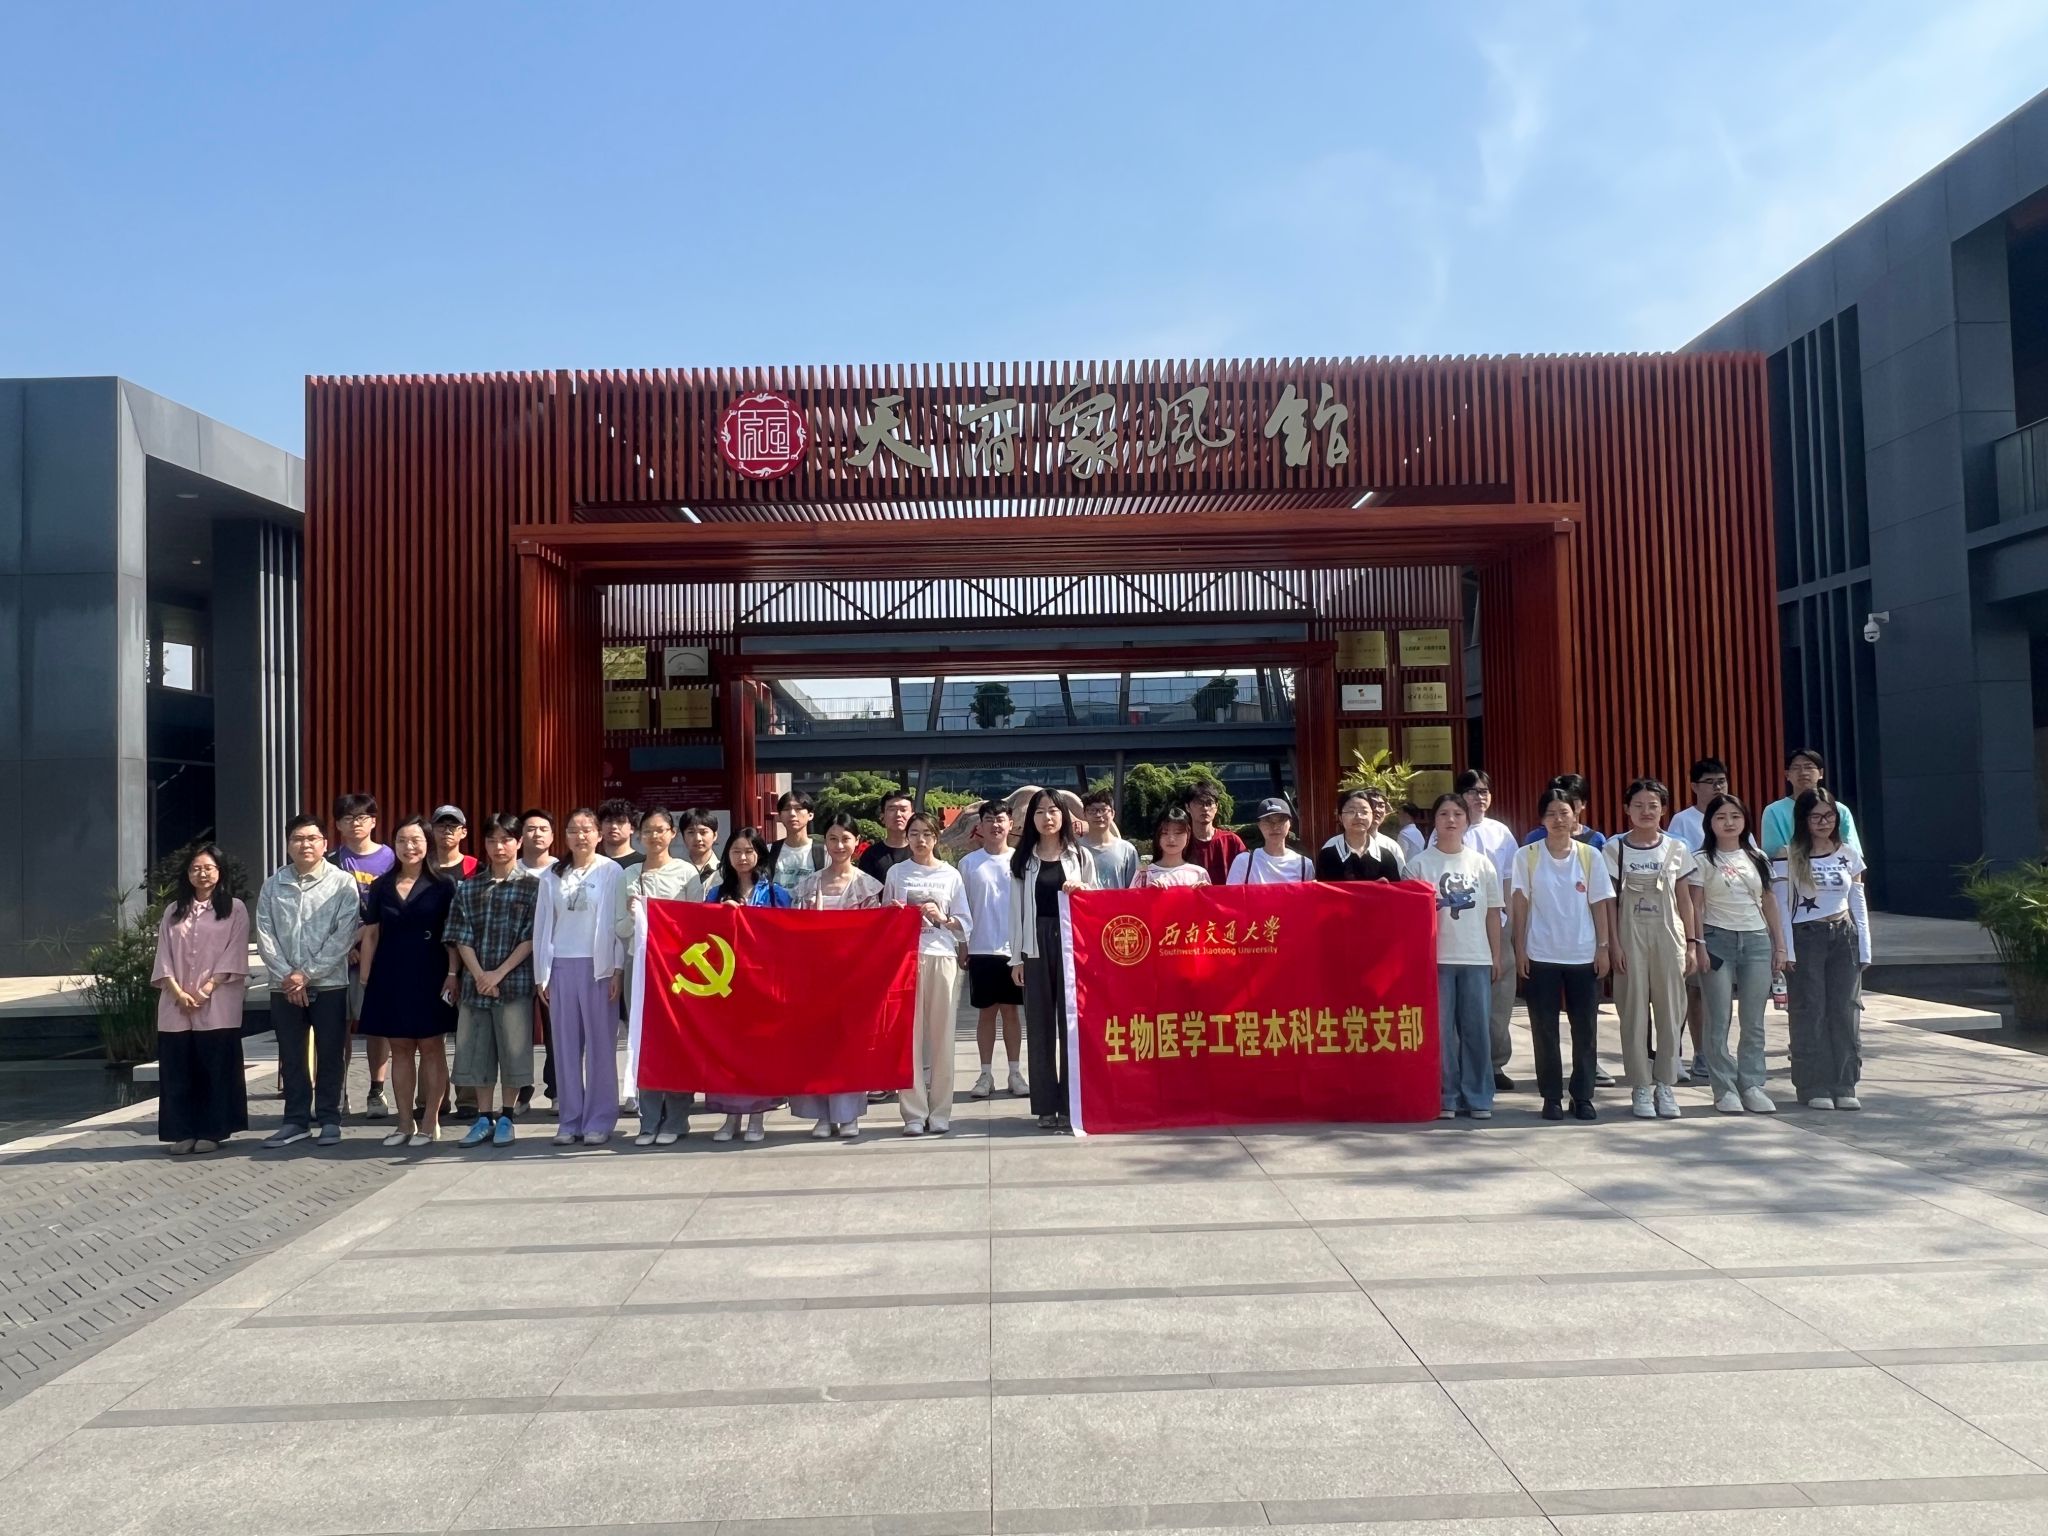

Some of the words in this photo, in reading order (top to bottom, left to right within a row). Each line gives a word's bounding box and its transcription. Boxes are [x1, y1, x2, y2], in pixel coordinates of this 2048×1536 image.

[1159, 947, 1200, 957] Southwest
[1202, 946, 1237, 957] Jiaotong
[1238, 945, 1278, 955] University
[1104, 1004, 1424, 1063] 生物医学工程本科生党支部
